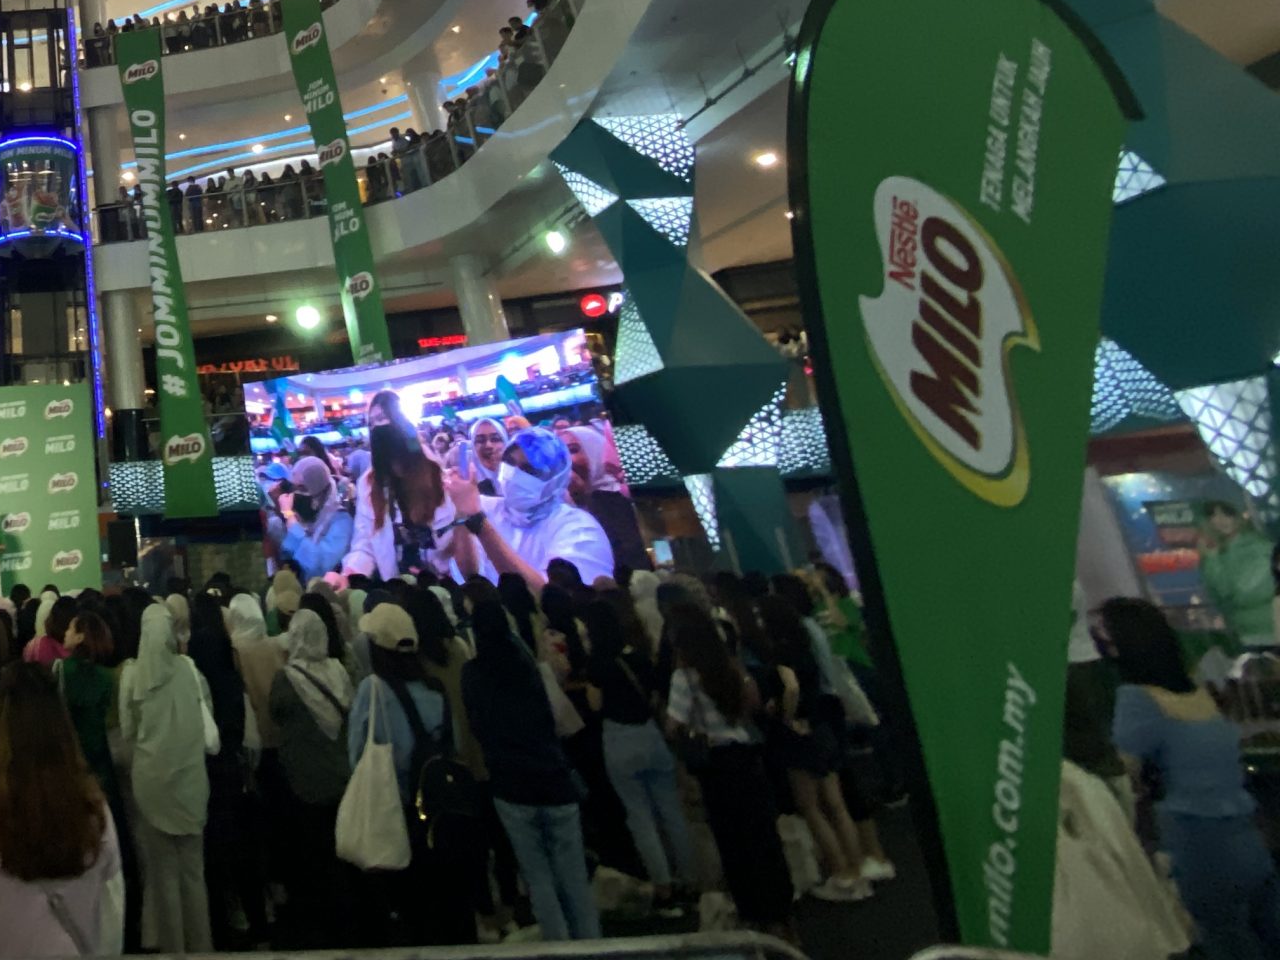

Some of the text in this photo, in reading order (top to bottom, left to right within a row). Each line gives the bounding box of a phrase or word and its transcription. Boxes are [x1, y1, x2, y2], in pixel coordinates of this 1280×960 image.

[128, 65, 156, 80] MILO
[888, 195, 919, 291] Nestlé
[349, 279, 370, 294] ILO
[909, 216, 984, 452] MILO
[45, 440, 76, 454] MILO
[168, 441, 202, 457] MILO
[48, 515, 80, 530] MILO
[1, 557, 32, 572] MILO
[983, 661, 1038, 947] milo.com.my
